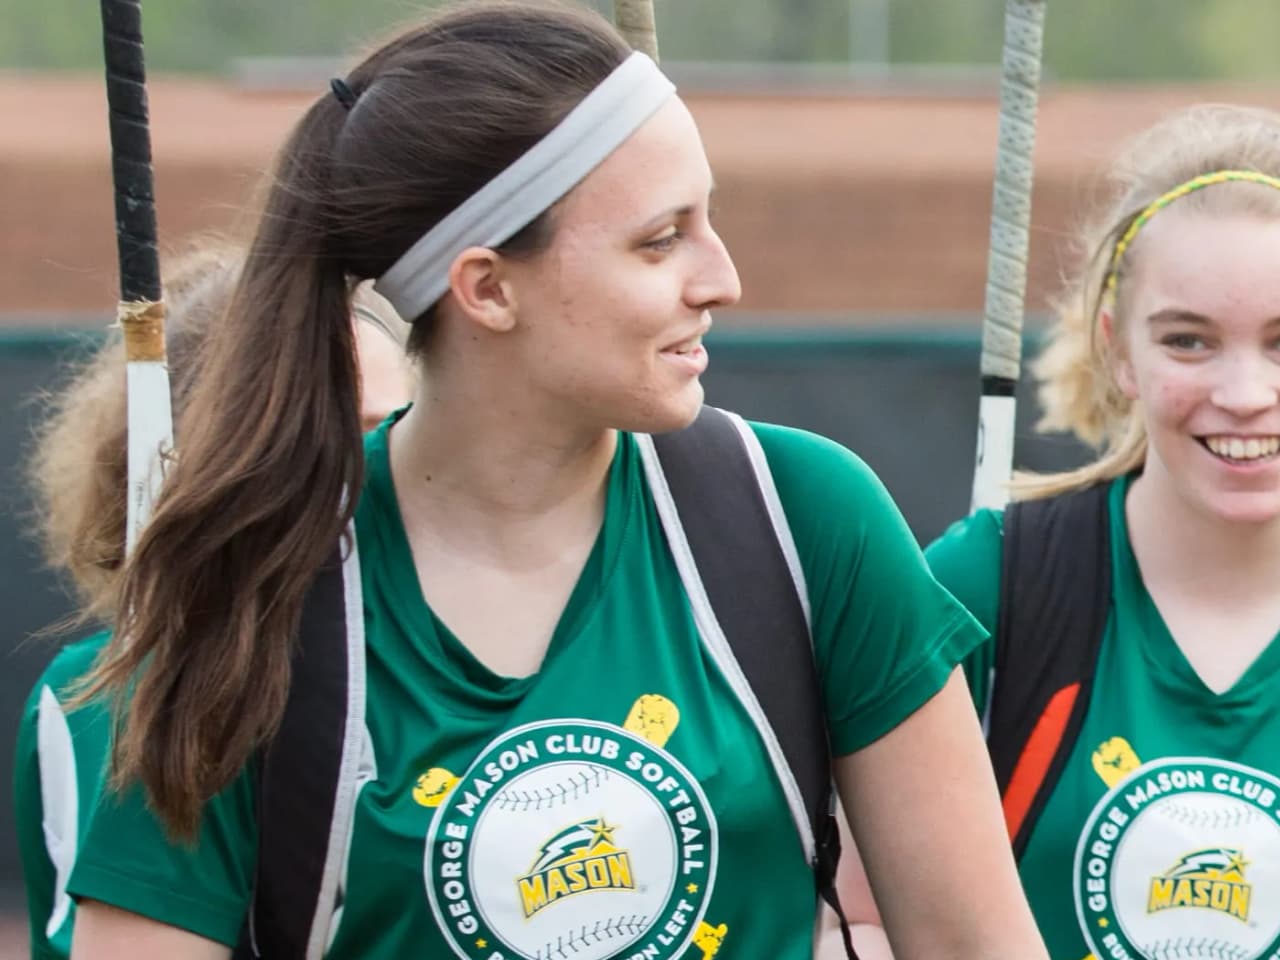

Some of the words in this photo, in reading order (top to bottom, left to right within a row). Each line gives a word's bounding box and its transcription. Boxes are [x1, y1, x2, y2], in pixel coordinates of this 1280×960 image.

[455, 740, 539, 817] MASON
[545, 734, 620, 760] CLUB
[625, 751, 704, 875] SOFTBALL
[1087, 806, 1129, 912] GEORGE
[1125, 770, 1205, 810] MASON
[1212, 772, 1277, 807] CLUB
[441, 823, 478, 935] GEORGE
[517, 852, 635, 919] MASON
[1148, 876, 1251, 923] MASON
[657, 900, 695, 946] LEFT
